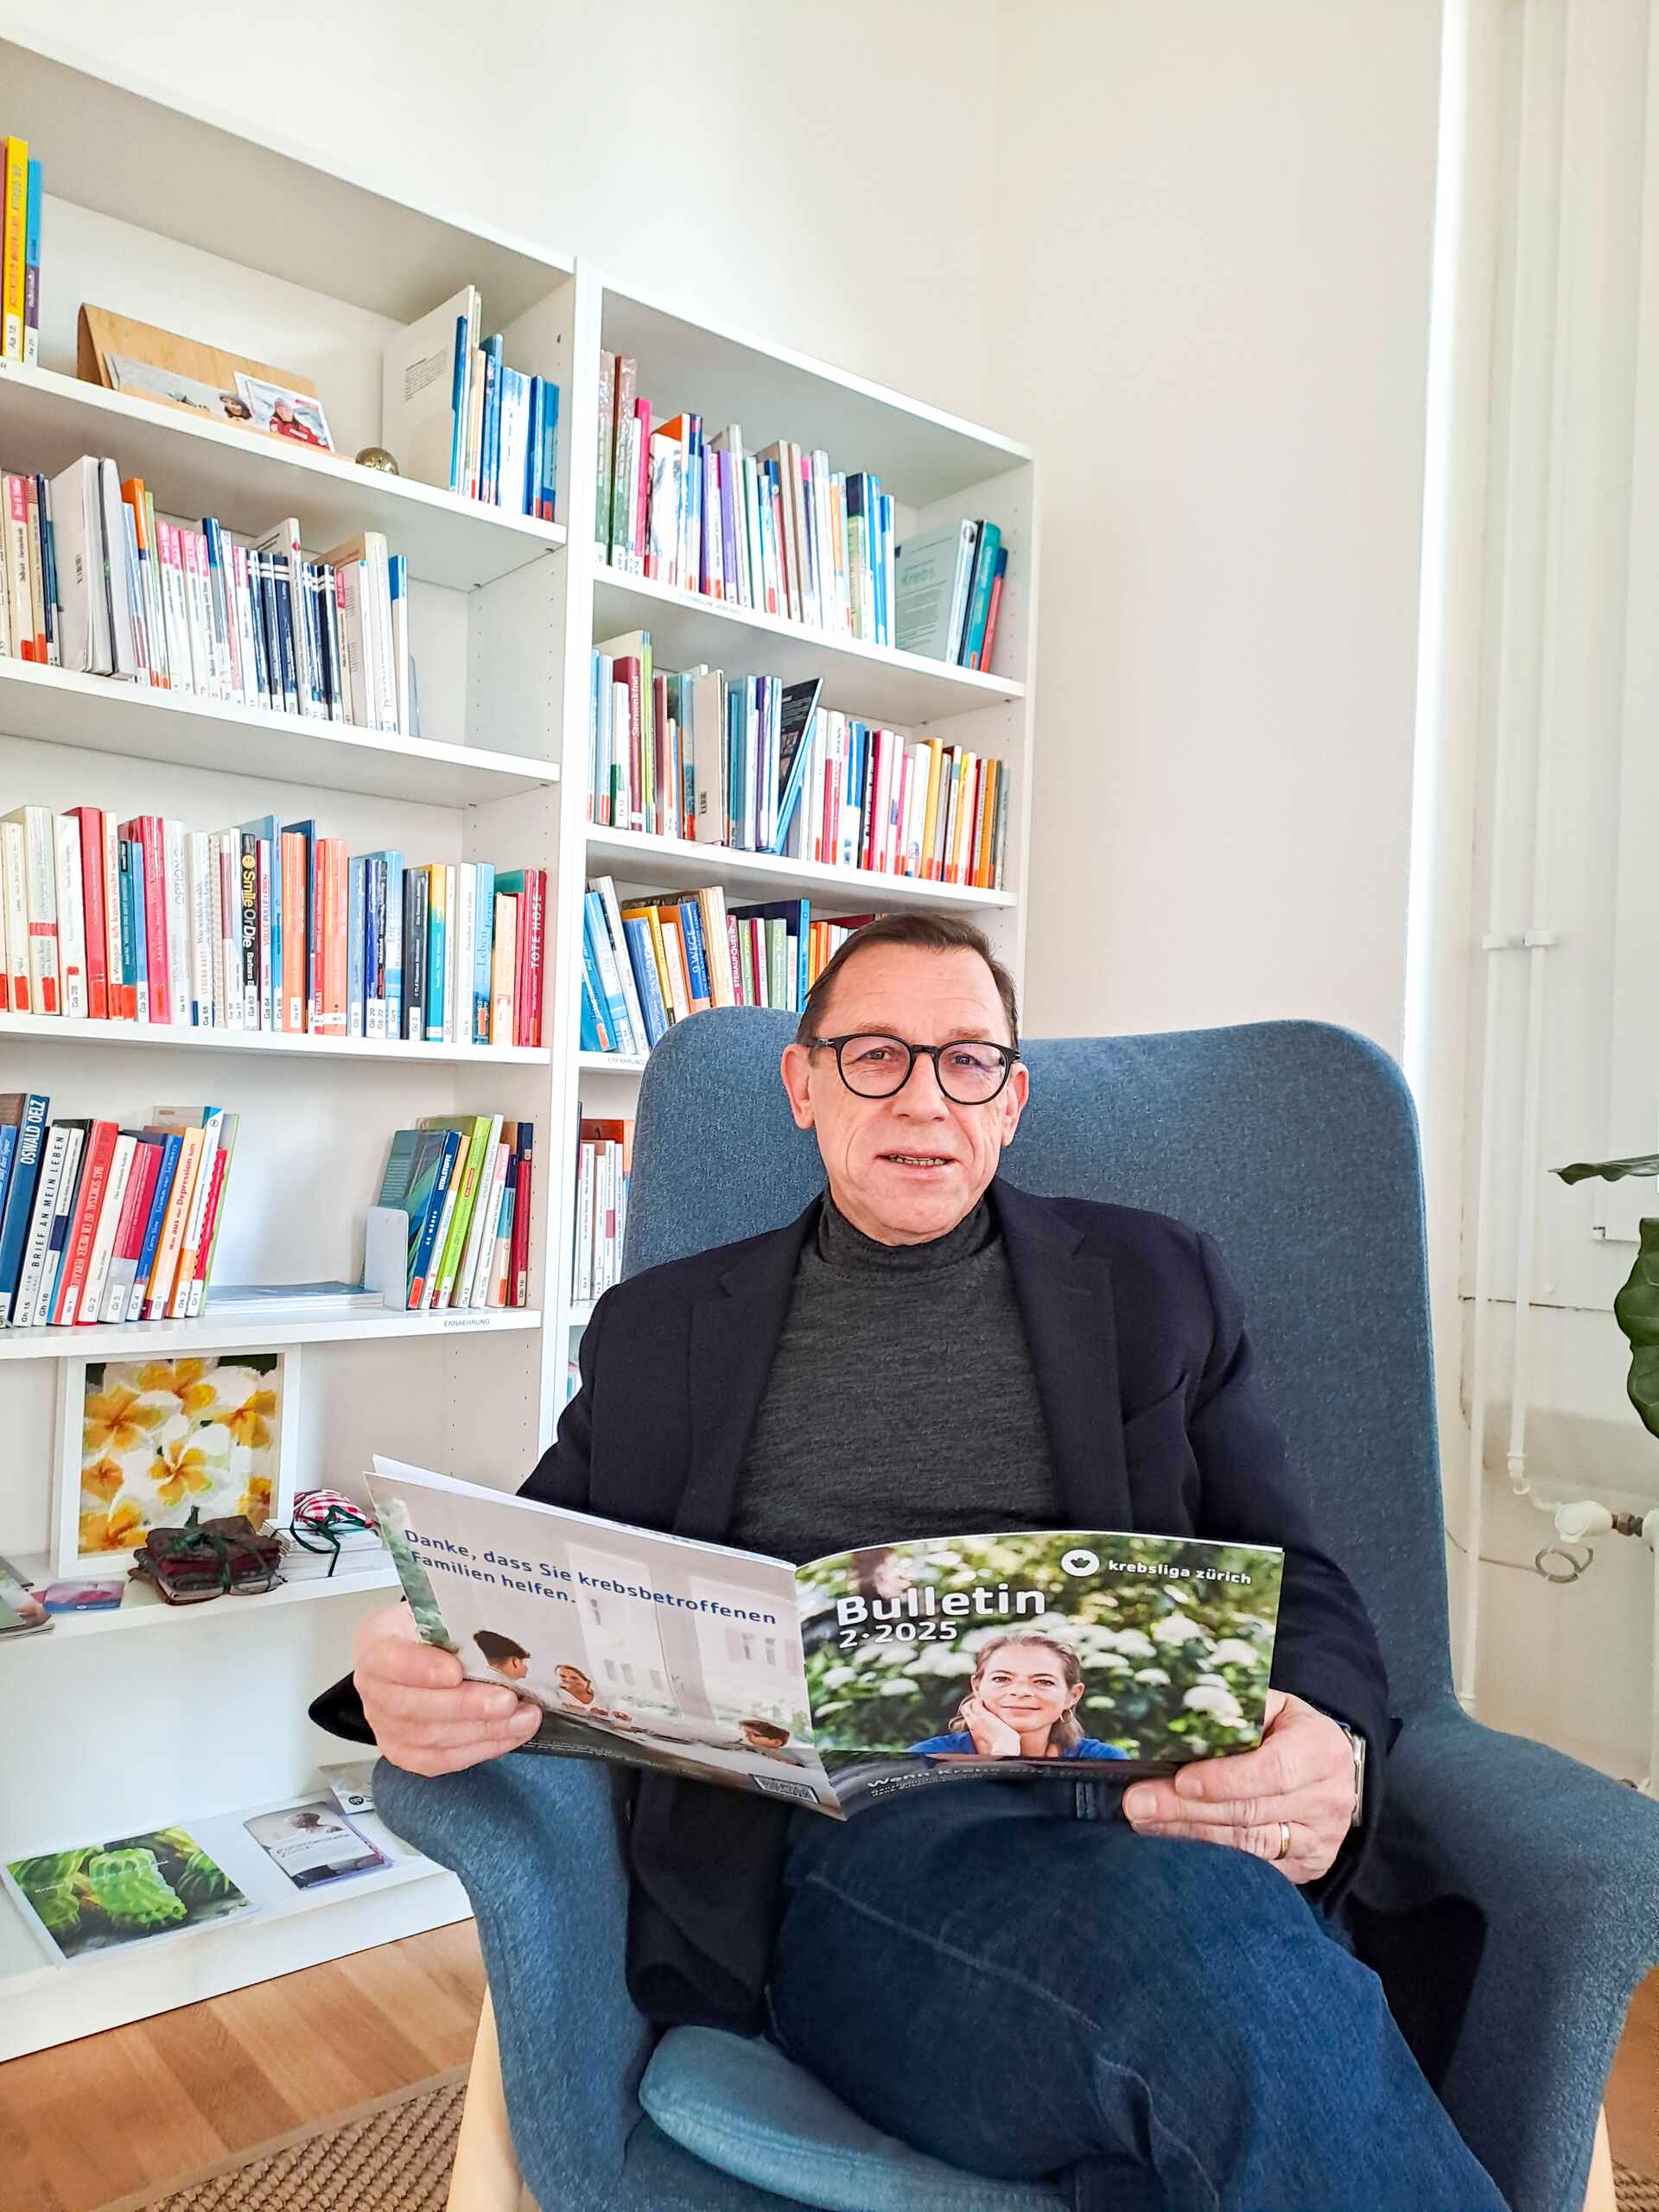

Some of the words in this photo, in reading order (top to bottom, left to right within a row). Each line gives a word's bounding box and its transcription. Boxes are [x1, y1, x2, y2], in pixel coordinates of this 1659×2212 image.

[243, 871, 255, 907] Smile
[531, 893, 542, 930] HOSE
[477, 931, 486, 966] Leben
[531, 934, 540, 968] TOTE
[730, 928, 740, 988] STEHAUFQUEEN
[248, 1007, 254, 1016] Ga
[264, 998, 270, 1007] 64
[264, 1008, 270, 1019] Ga
[203, 1016, 209, 1026] Ga
[27, 1100, 45, 1122] OELZ
[20, 1128, 40, 1165] OSWALD
[50, 1136, 64, 1173] LEBEN
[438, 1154, 452, 1191] VITALSTOFFE
[43, 1178, 56, 1206] MEIN
[171, 1220, 180, 1235] aus
[176, 1158, 192, 1205] Depression
[40, 1213, 49, 1226] AN
[31, 1233, 45, 1267] BRIEF
[404, 1528, 477, 1562] Danke,
[483, 1549, 532, 1573] dass
[538, 1561, 572, 1582] Sie
[578, 1572, 777, 1624] krebsbetroffenen
[411, 1549, 496, 1585] Familien
[501, 1573, 576, 1604] helfen.
[1108, 1559, 1190, 1579] krebsliga
[1196, 1564, 1252, 1585] zürich
[836, 1583, 1046, 1627] Bulletin
